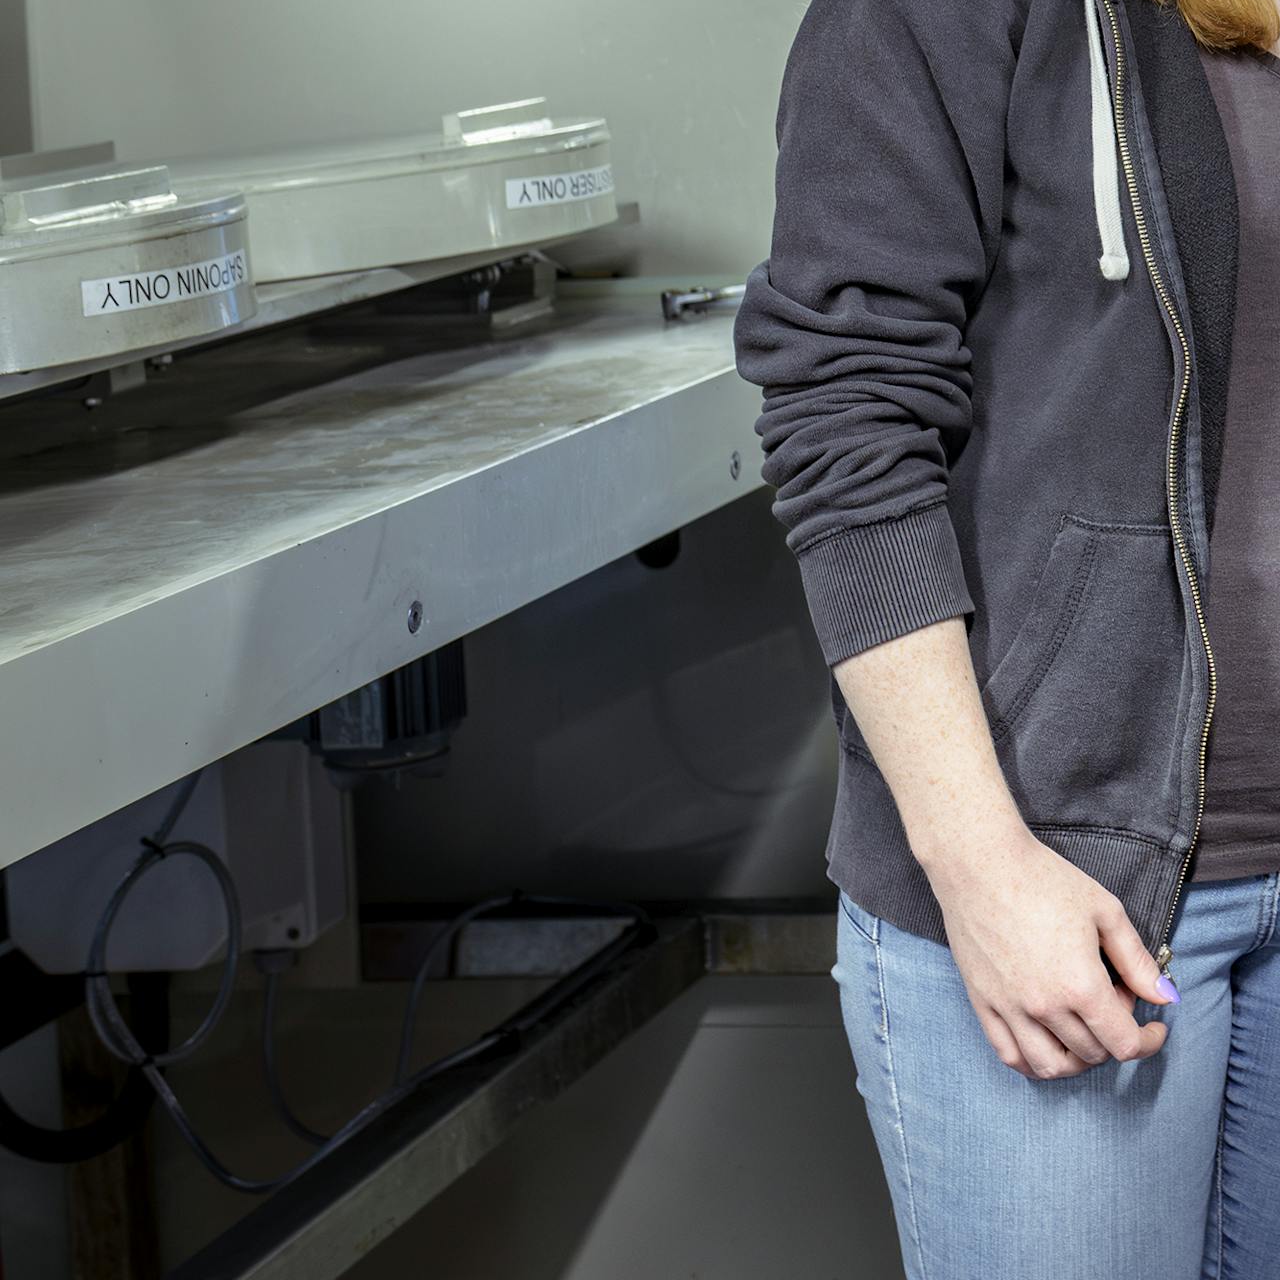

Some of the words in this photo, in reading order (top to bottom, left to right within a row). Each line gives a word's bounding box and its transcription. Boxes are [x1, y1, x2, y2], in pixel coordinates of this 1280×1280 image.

[519, 177, 567, 203] ONLY
[101, 273, 171, 309] ONLY
[177, 254, 243, 297] SAPONIN
